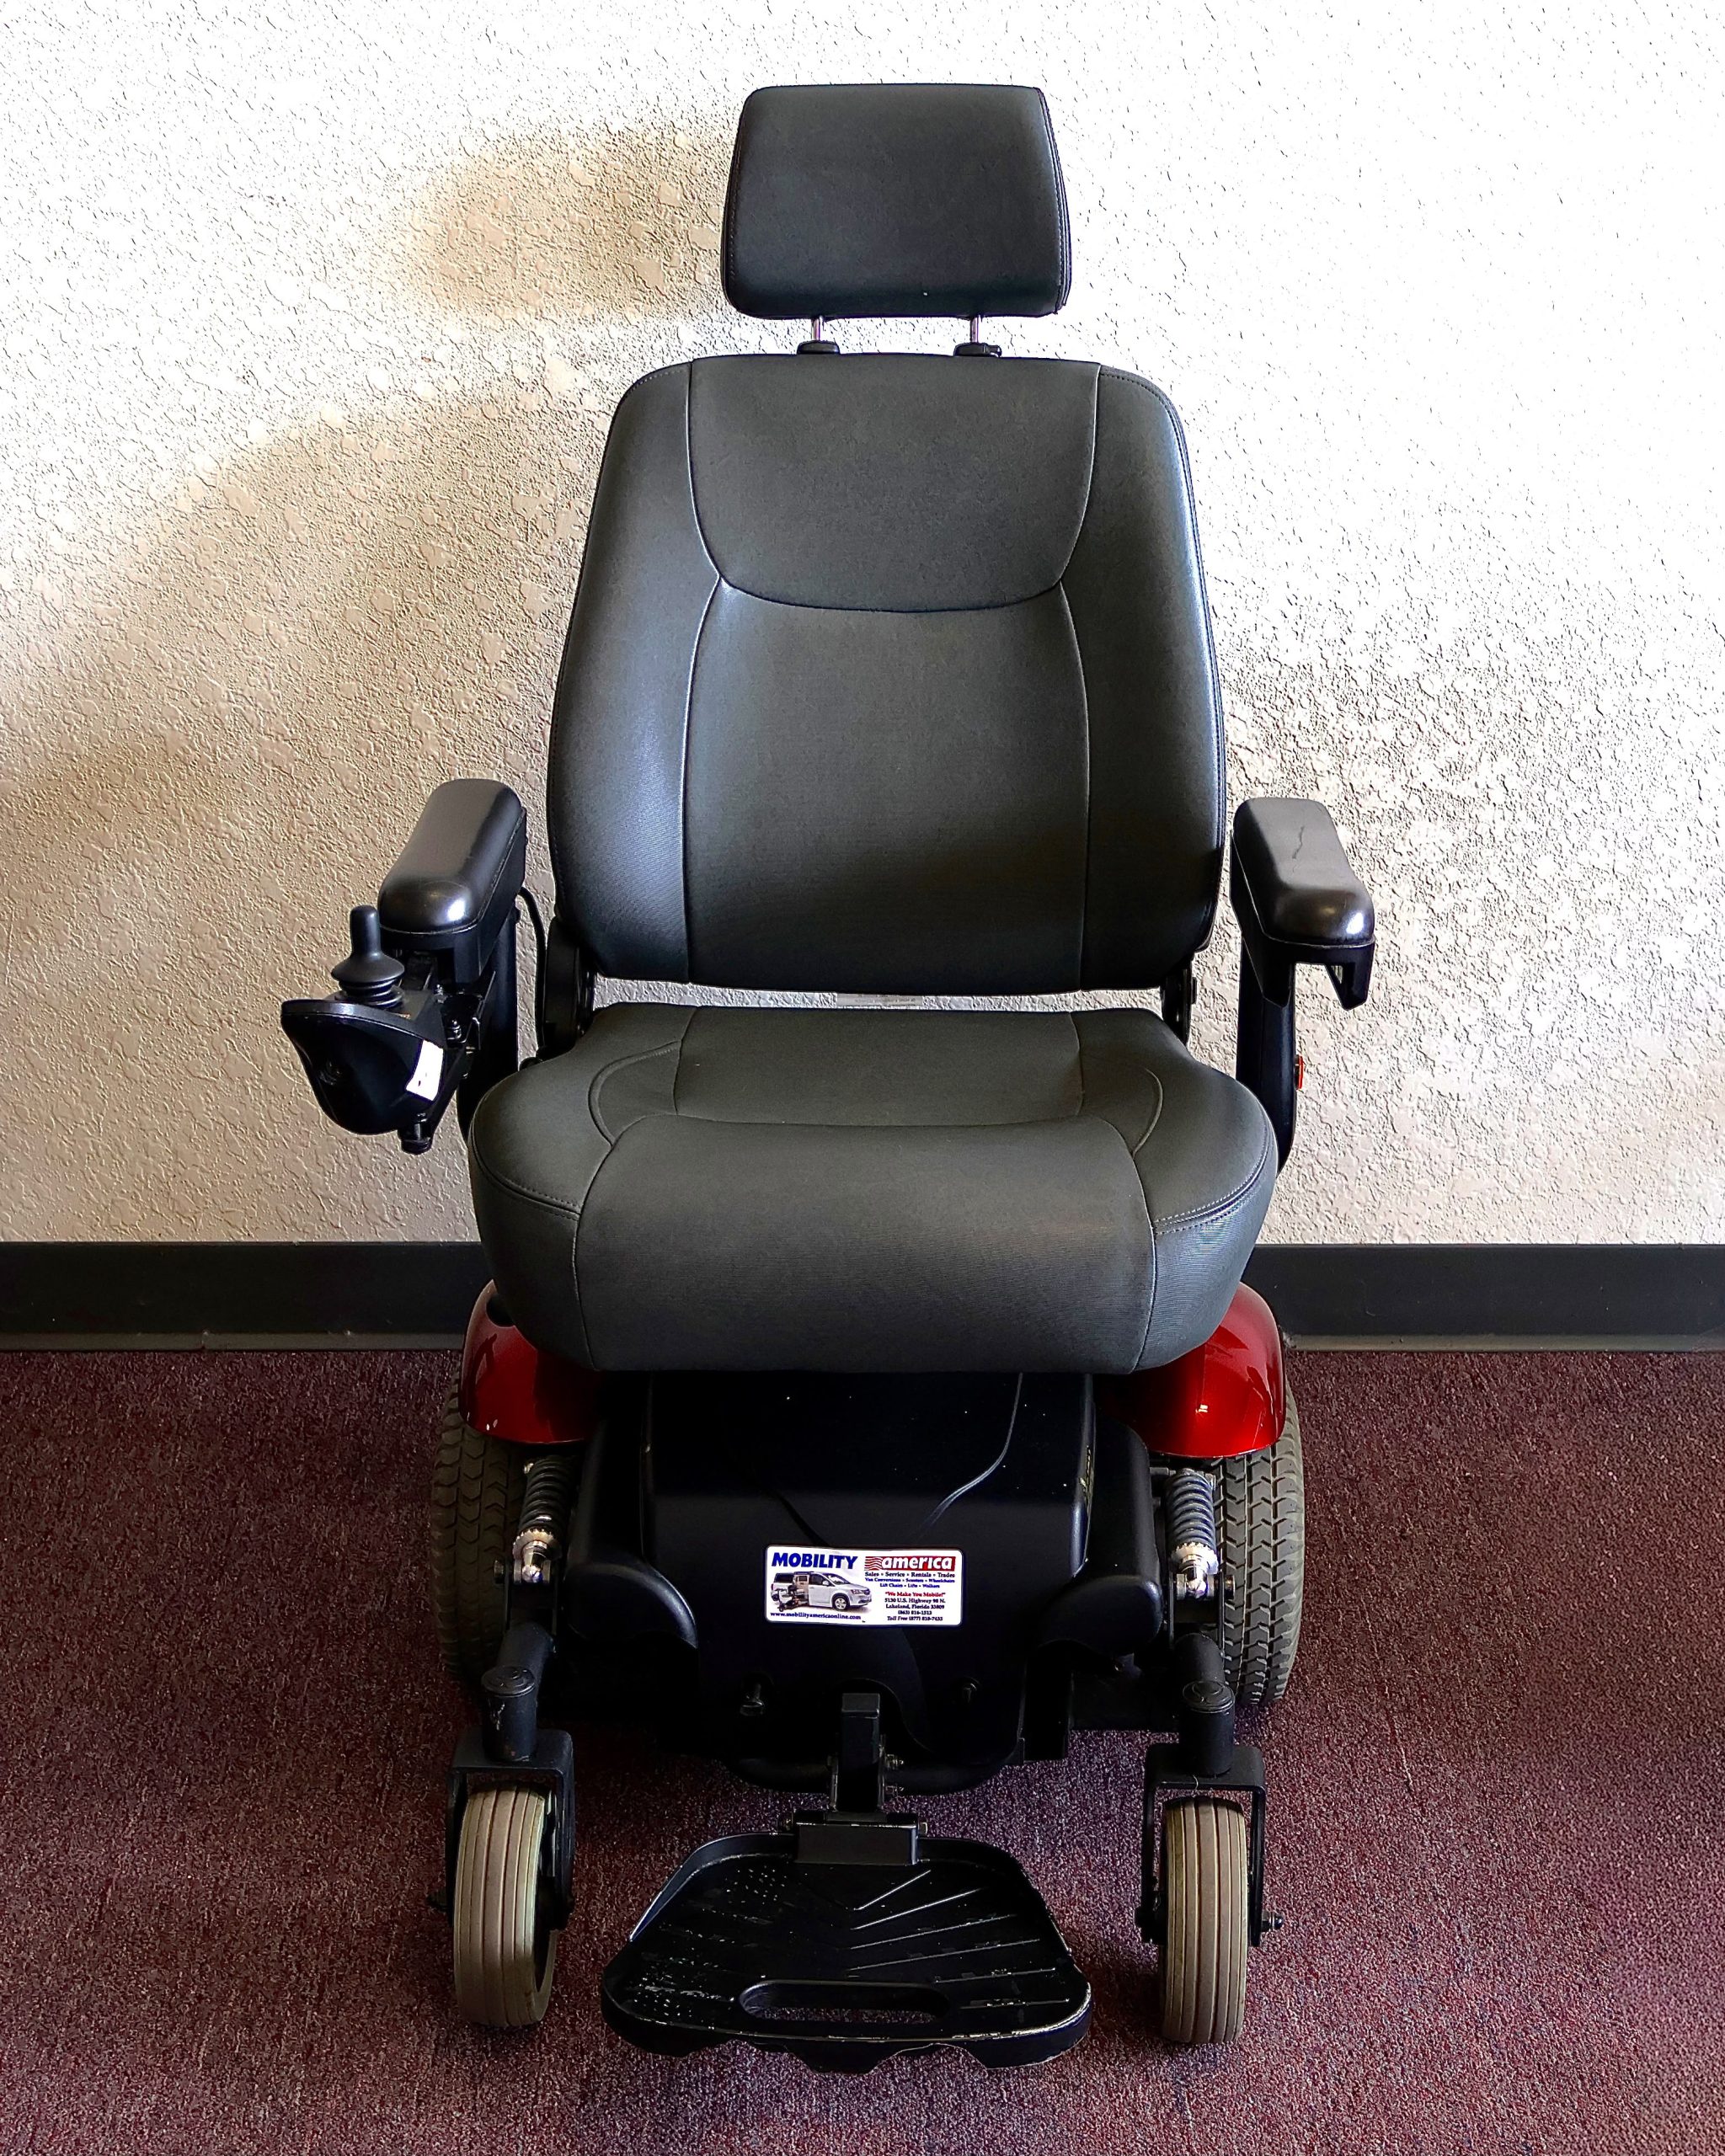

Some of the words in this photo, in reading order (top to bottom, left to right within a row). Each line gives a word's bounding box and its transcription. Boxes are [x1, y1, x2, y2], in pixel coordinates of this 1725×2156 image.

[772, 1552, 858, 1569] MOBILITY
[881, 1556, 953, 1569] america
[770, 1611, 862, 1620] www.mobilityamericaonline.com
